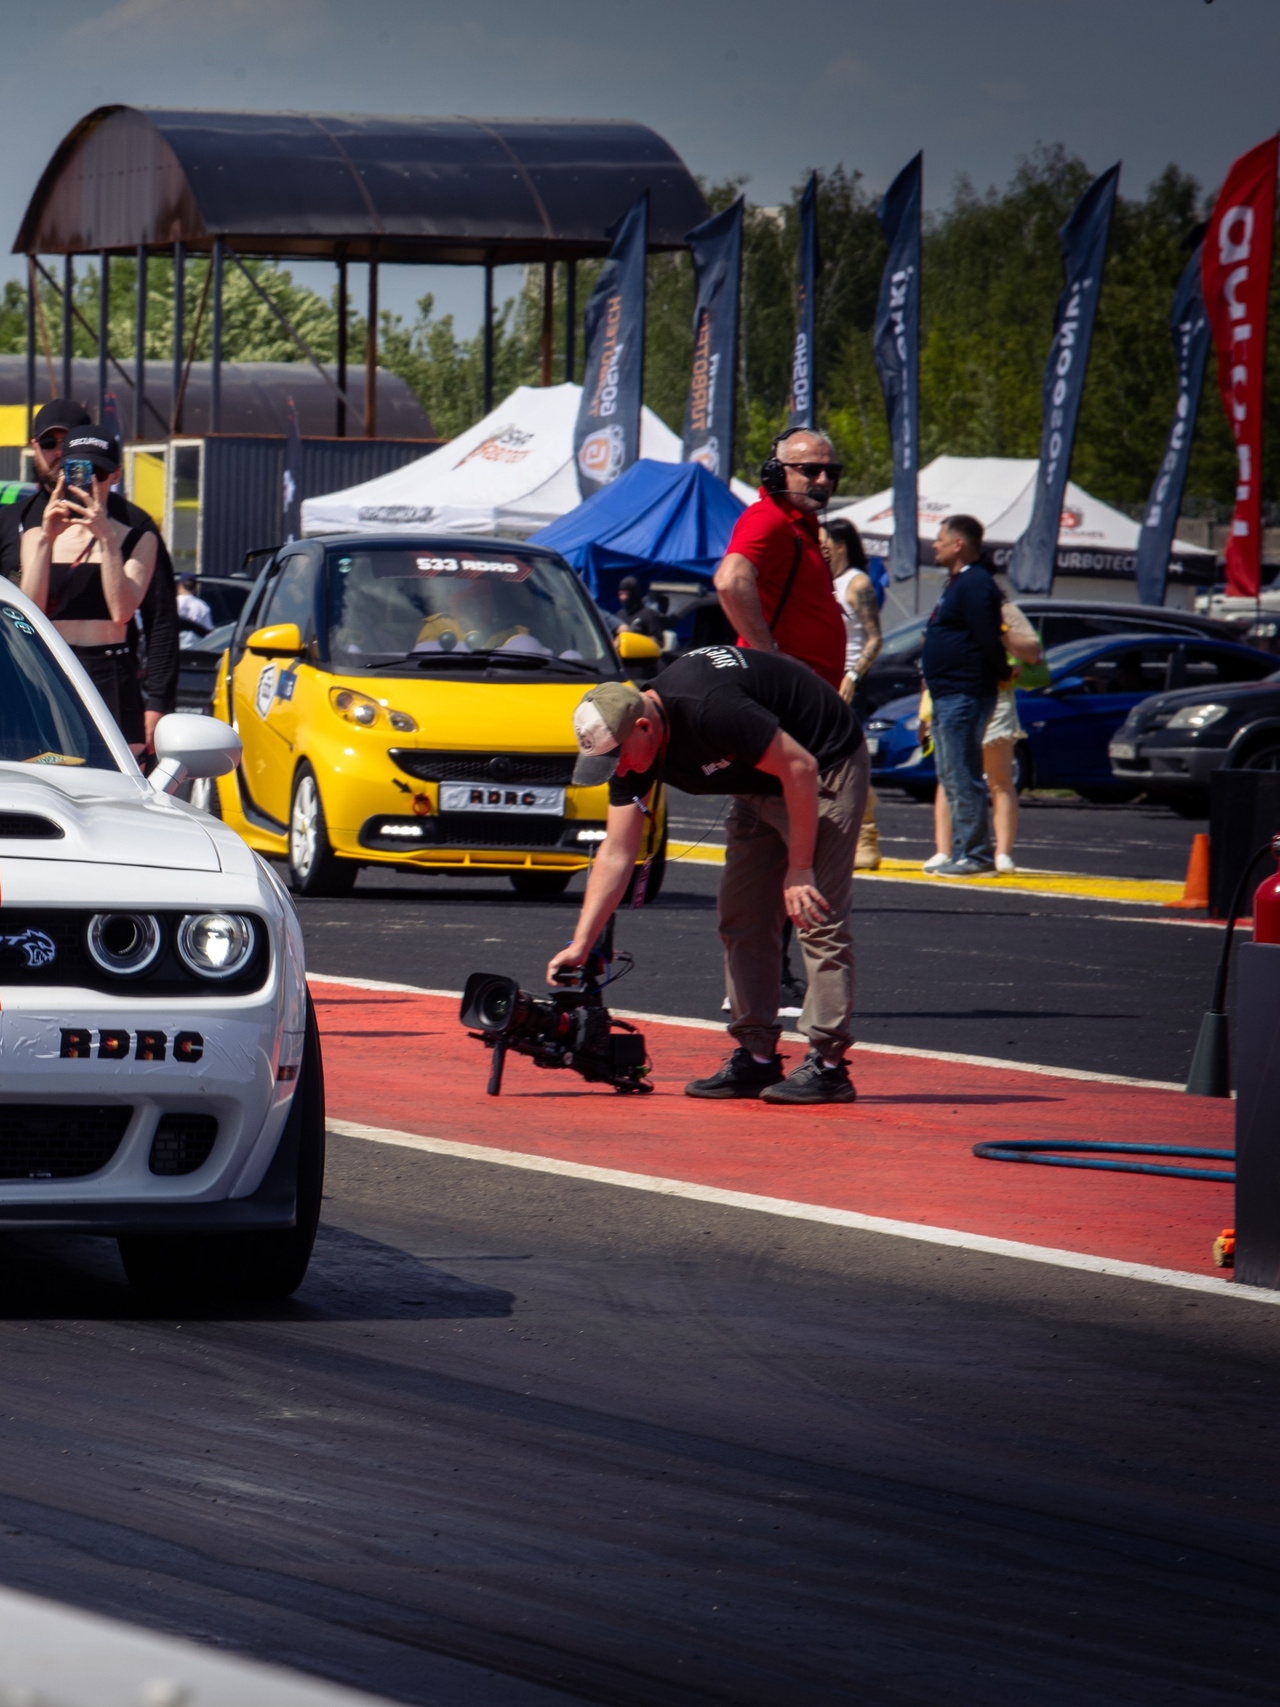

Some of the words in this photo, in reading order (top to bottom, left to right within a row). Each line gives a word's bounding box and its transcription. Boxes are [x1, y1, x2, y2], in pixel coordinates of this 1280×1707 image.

[416, 557, 458, 571] 533
[470, 789, 536, 806] RDRC
[59, 1027, 204, 1063] RDRC
